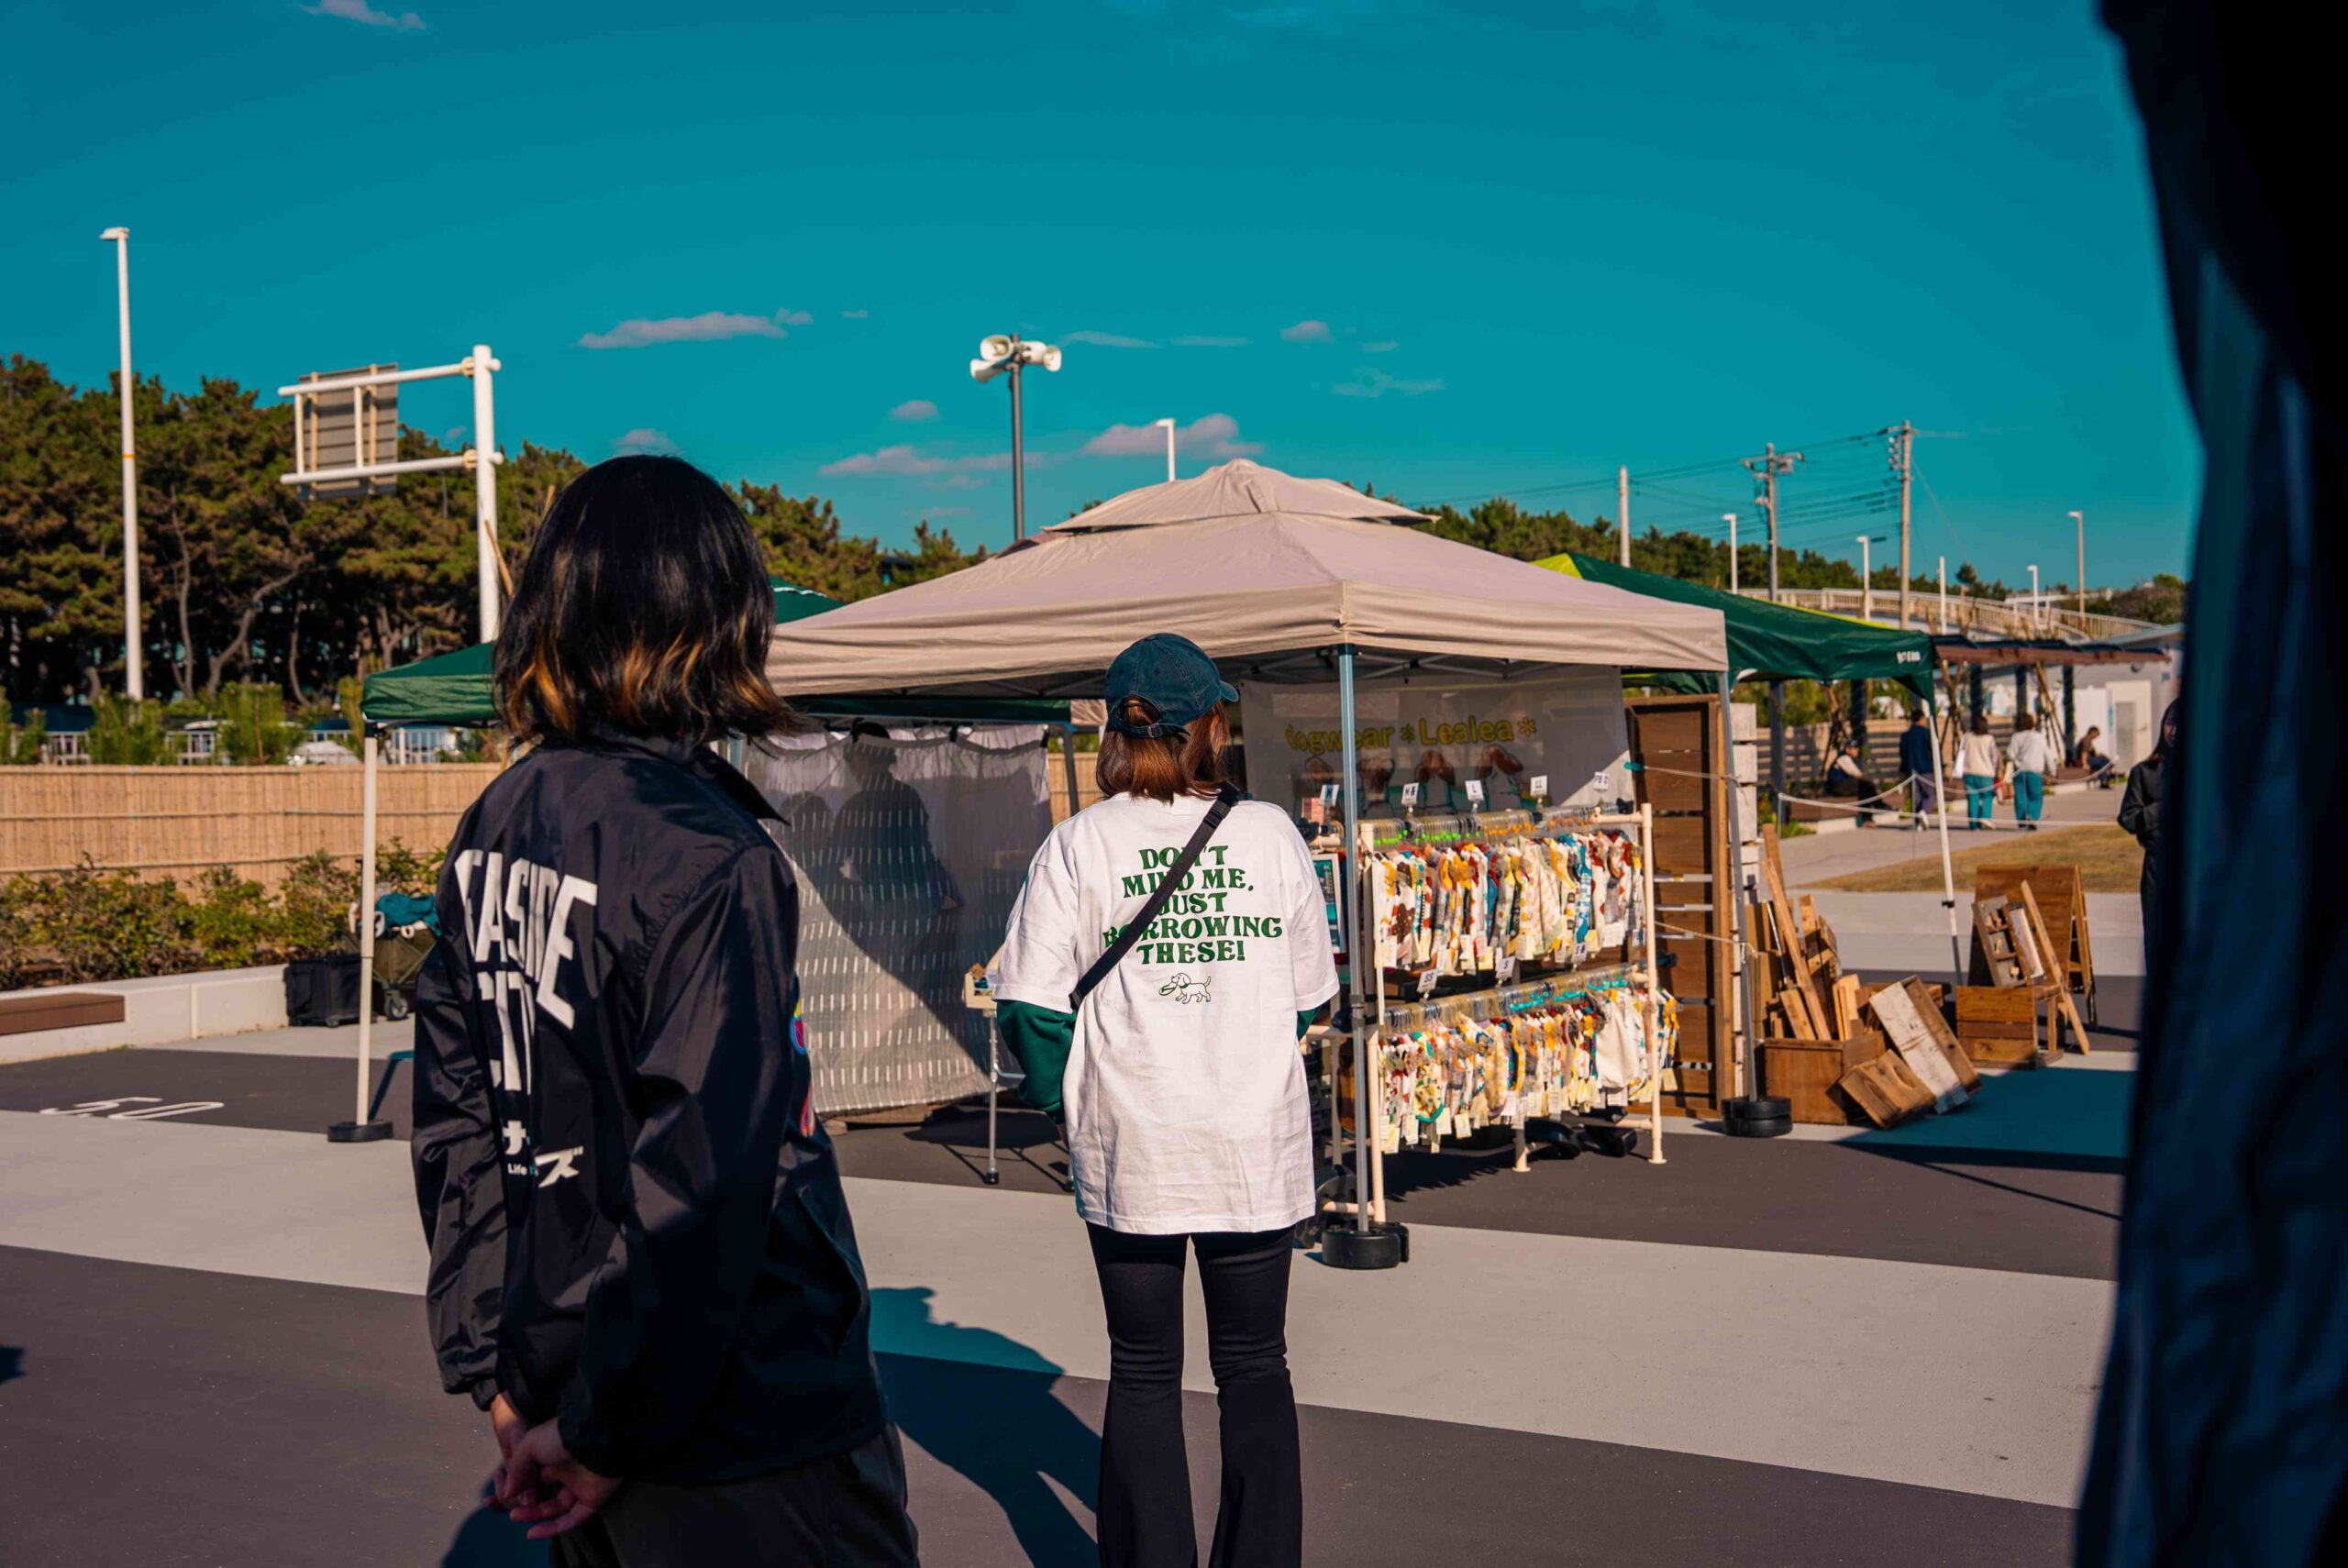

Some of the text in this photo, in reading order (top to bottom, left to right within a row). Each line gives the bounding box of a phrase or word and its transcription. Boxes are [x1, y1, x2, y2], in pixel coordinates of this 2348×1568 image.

[1138, 845, 1228, 870] DO'T
[1202, 867, 1255, 891] ME.
[1157, 892, 1228, 917] JUST
[1135, 940, 1246, 966] THESE!
